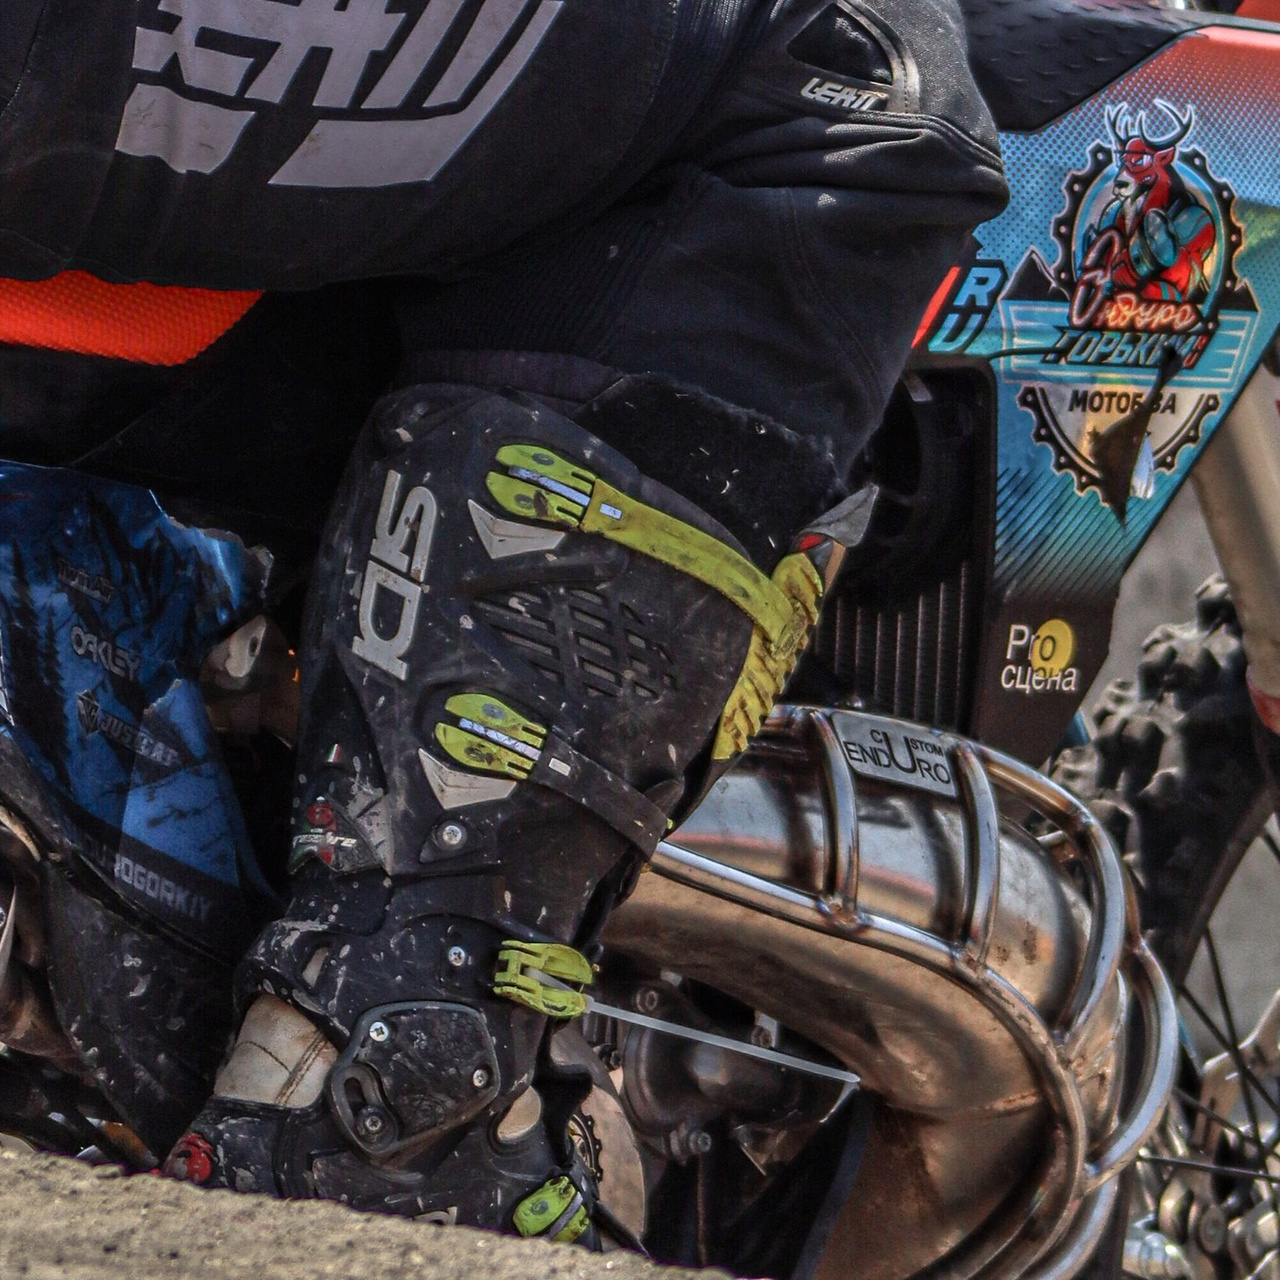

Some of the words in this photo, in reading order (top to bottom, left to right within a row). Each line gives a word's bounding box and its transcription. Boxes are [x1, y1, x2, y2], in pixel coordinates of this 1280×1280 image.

[800, 77, 889, 111] LEATT
[1068, 389, 1177, 415] МОТОБЗА
[71, 626, 140, 682] OAKLEY
[1006, 624, 1057, 661] Pro
[1001, 665, 1078, 694] сцена
[842, 731, 952, 785] ENDURO
